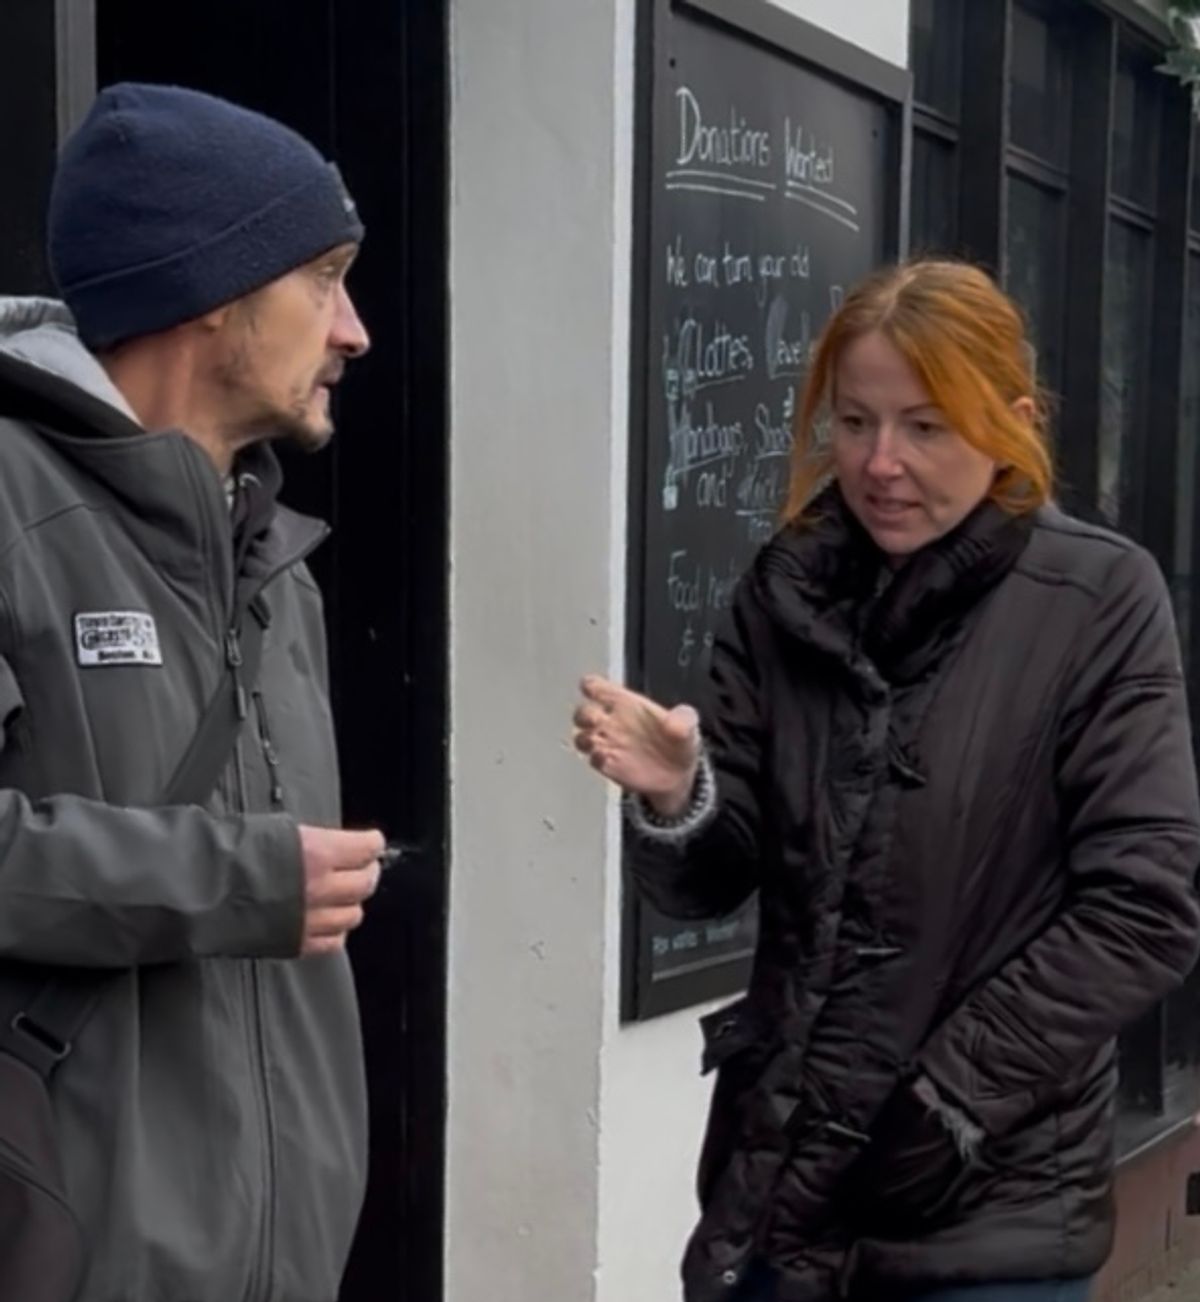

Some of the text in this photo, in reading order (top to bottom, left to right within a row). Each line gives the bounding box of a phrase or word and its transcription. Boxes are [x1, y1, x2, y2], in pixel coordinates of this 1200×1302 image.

[676, 86, 769, 167] Donations
[666, 236, 689, 287] We
[694, 253, 719, 288] can
[722, 243, 753, 285] turn
